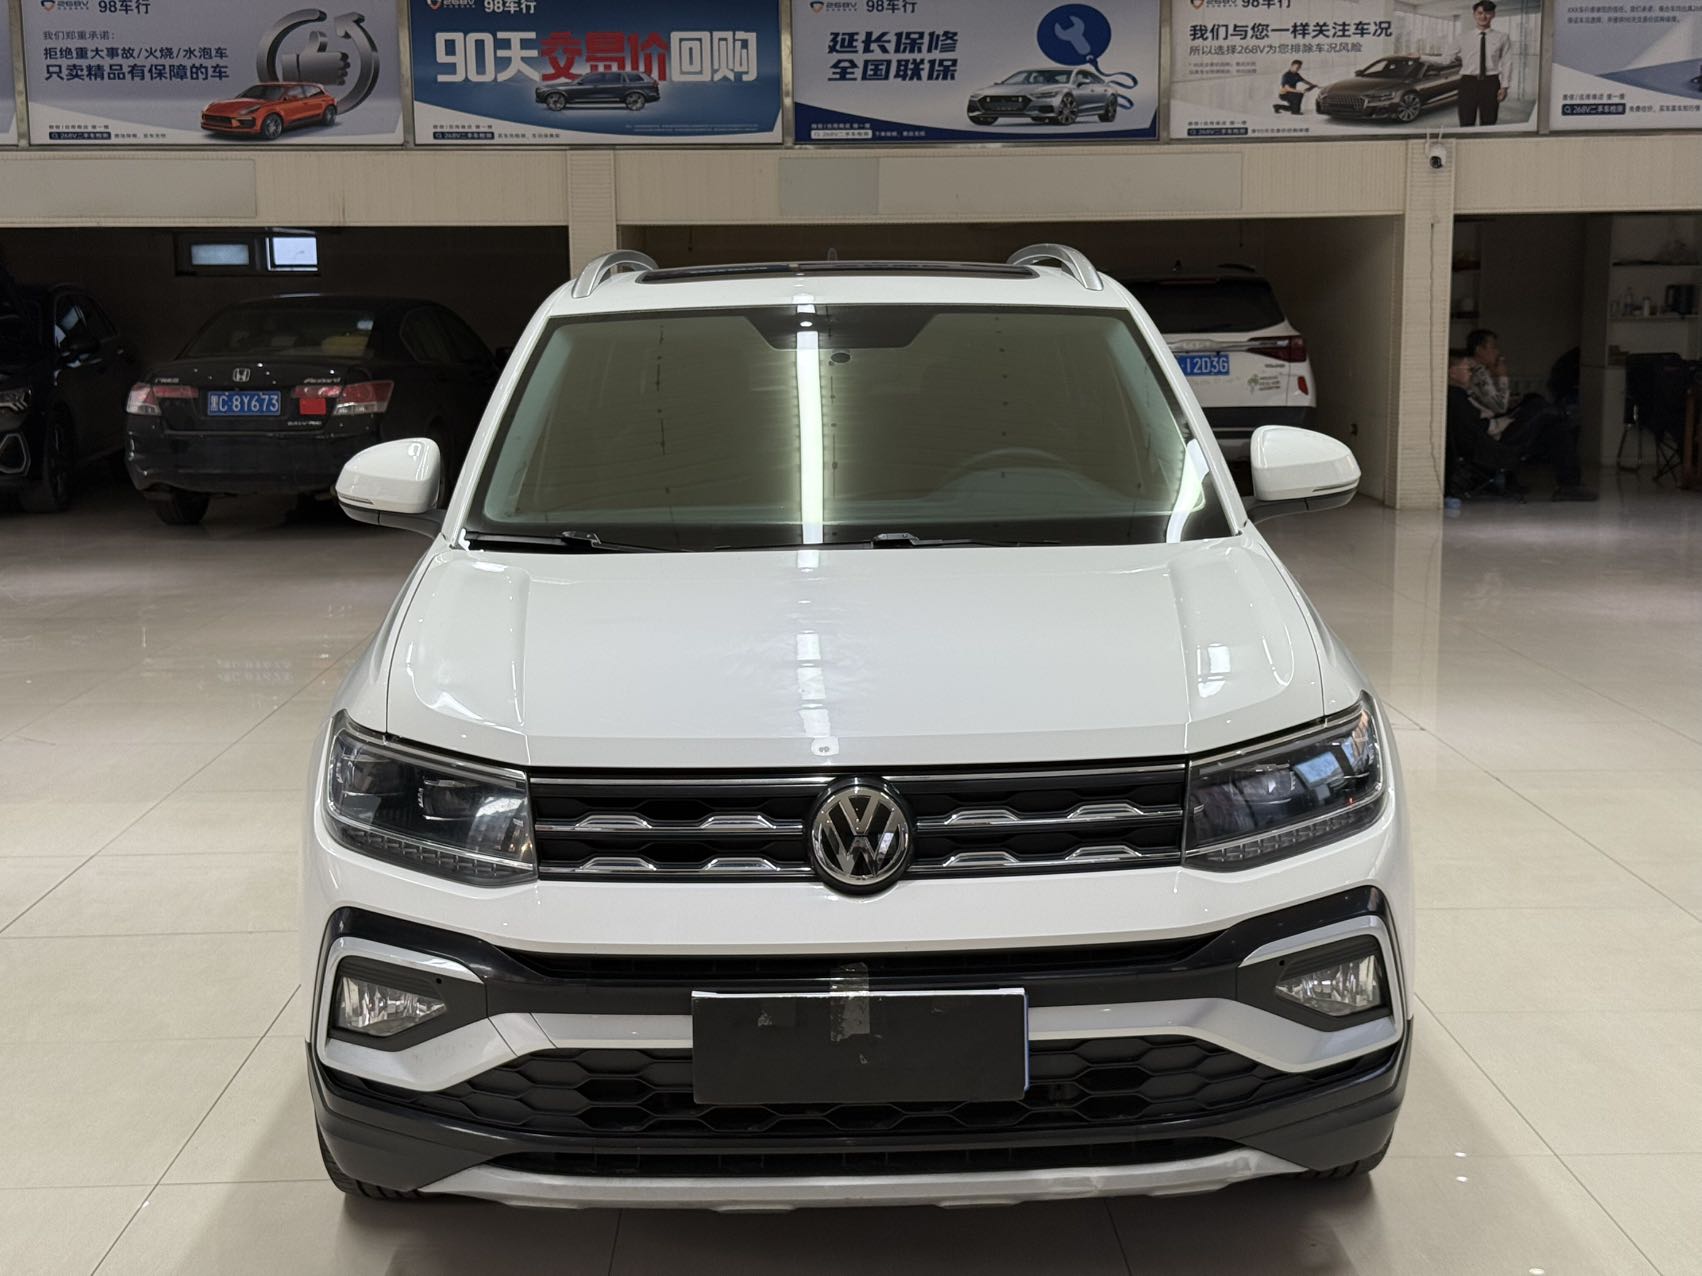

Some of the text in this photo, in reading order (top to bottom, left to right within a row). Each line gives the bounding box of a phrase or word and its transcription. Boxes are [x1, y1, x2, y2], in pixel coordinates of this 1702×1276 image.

[98, 0, 151, 14] 98车行
[484, 0, 536, 14] 98车行
[866, 0, 917, 13] 98车行
[1189, 20, 1392, 41] 我们与您一样关注车况
[827, 31, 958, 54] 延长保修
[1189, 41, 1363, 56] 所以选择268V为您排除车况风险
[43, 47, 229, 60] 拒绝重大事故/火烧/水泡车
[435, 31, 757, 82] 90天交易价回购
[45, 63, 230, 81] 只卖精品有保障的车
[827, 58, 958, 81] 全国联保
